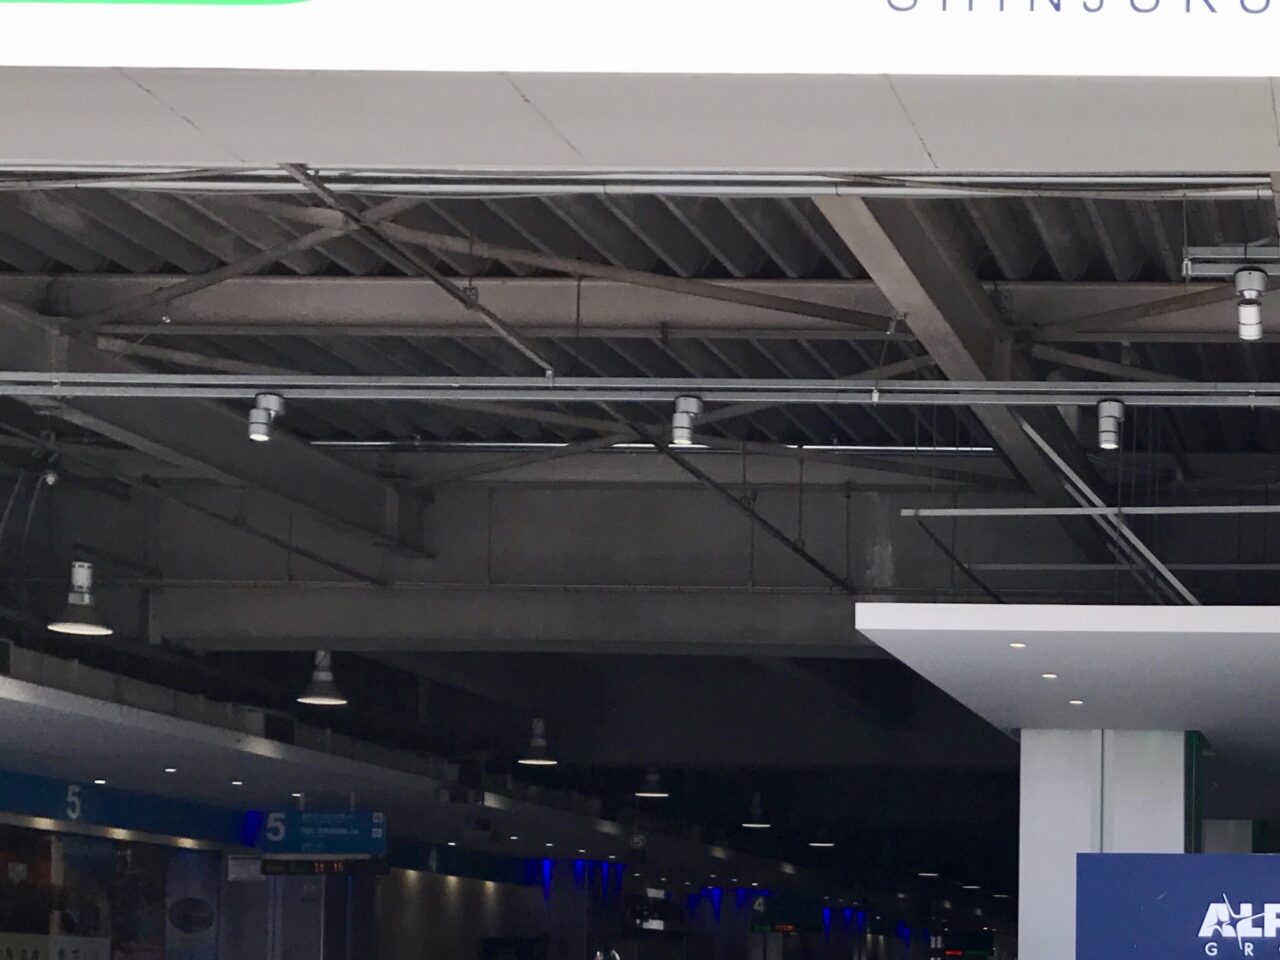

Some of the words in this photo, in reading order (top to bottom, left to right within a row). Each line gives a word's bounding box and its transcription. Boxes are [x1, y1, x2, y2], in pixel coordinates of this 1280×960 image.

[66, 784, 82, 820] 5
[265, 811, 287, 842] 5
[752, 896, 766, 913] 4
